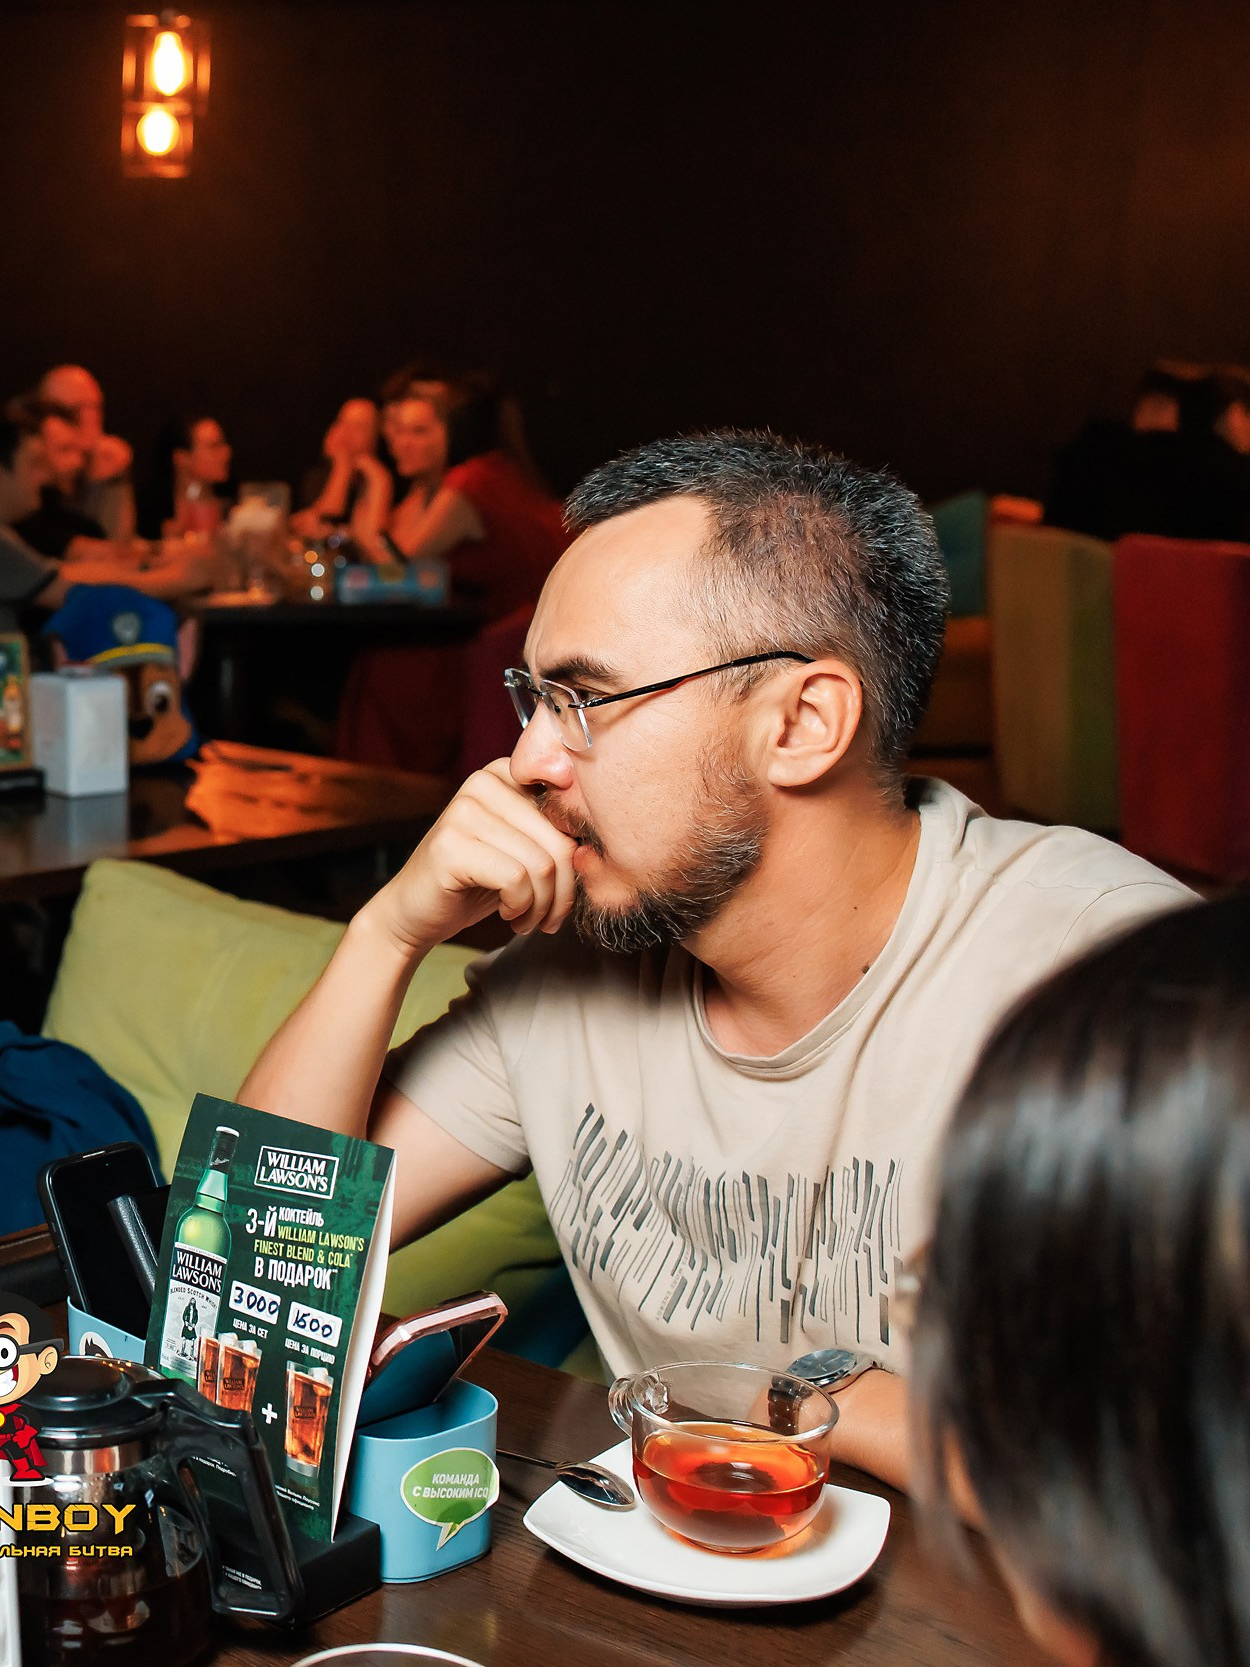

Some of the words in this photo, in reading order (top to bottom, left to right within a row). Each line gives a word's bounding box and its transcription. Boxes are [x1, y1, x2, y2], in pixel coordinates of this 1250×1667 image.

[267, 1151, 327, 1175] WILLIAM
[259, 1166, 328, 1192] LAWSON'S
[245, 1205, 278, 1237] 3-Й
[278, 1206, 325, 1228] КОКТЕЙЛЬ
[278, 1225, 317, 1244] WILLIAM
[318, 1231, 365, 1252] LAWSON'S
[253, 1239, 284, 1257] FINEST
[286, 1244, 315, 1262] BLEND
[317, 1249, 325, 1264] &
[176, 1250, 223, 1279] WILLIAM
[254, 1256, 265, 1278] В
[172, 1264, 222, 1294] LAWSON'S
[234, 1286, 280, 1315] 3000
[232, 1317, 248, 1332] ЦЕНА
[248, 1323, 257, 1335] ЗА
[257, 1326, 269, 1339] СЕТ
[284, 1337, 300, 1352] ЦЕНА
[301, 1343, 310, 1355] ЗА
[412, 1485, 422, 1497] С
[422, 1486, 473, 1498] ВЫСОКИМ
[432, 1473, 480, 1486] КОМАНДА
